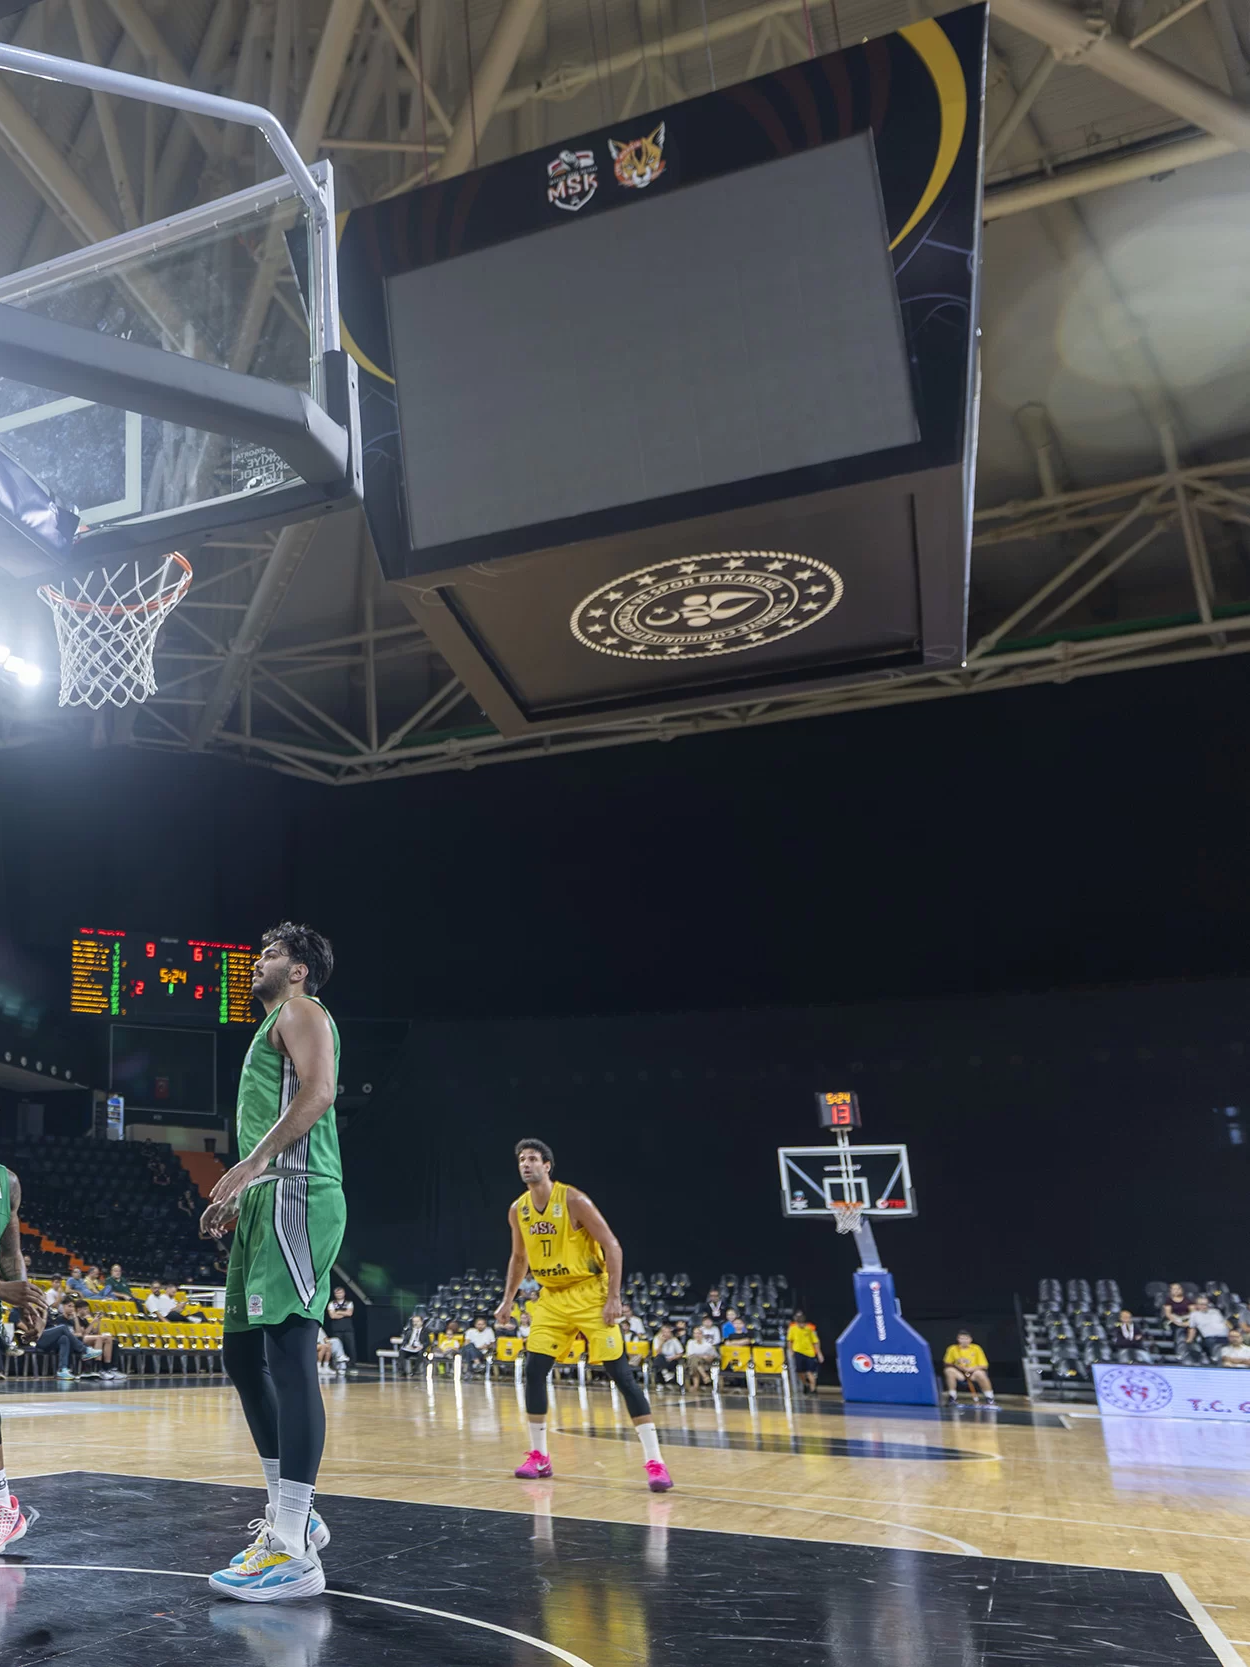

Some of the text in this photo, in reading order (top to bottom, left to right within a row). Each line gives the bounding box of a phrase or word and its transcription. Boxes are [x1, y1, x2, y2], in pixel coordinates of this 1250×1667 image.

[547, 172, 599, 203] MSK
[650, 580, 695, 596] SPOR
[145, 941, 156, 958] 9
[192, 946, 203, 962] 6
[159, 967, 188, 984] 5:24
[135, 980, 145, 995] 2
[194, 985, 204, 999] 2
[831, 1104, 851, 1125] 13
[530, 1221, 558, 1235] MSK
[871, 1354, 917, 1365] TÜRKİYE
[873, 1364, 920, 1374] SİGORTA
[1188, 1398, 1232, 1413] T.C.
